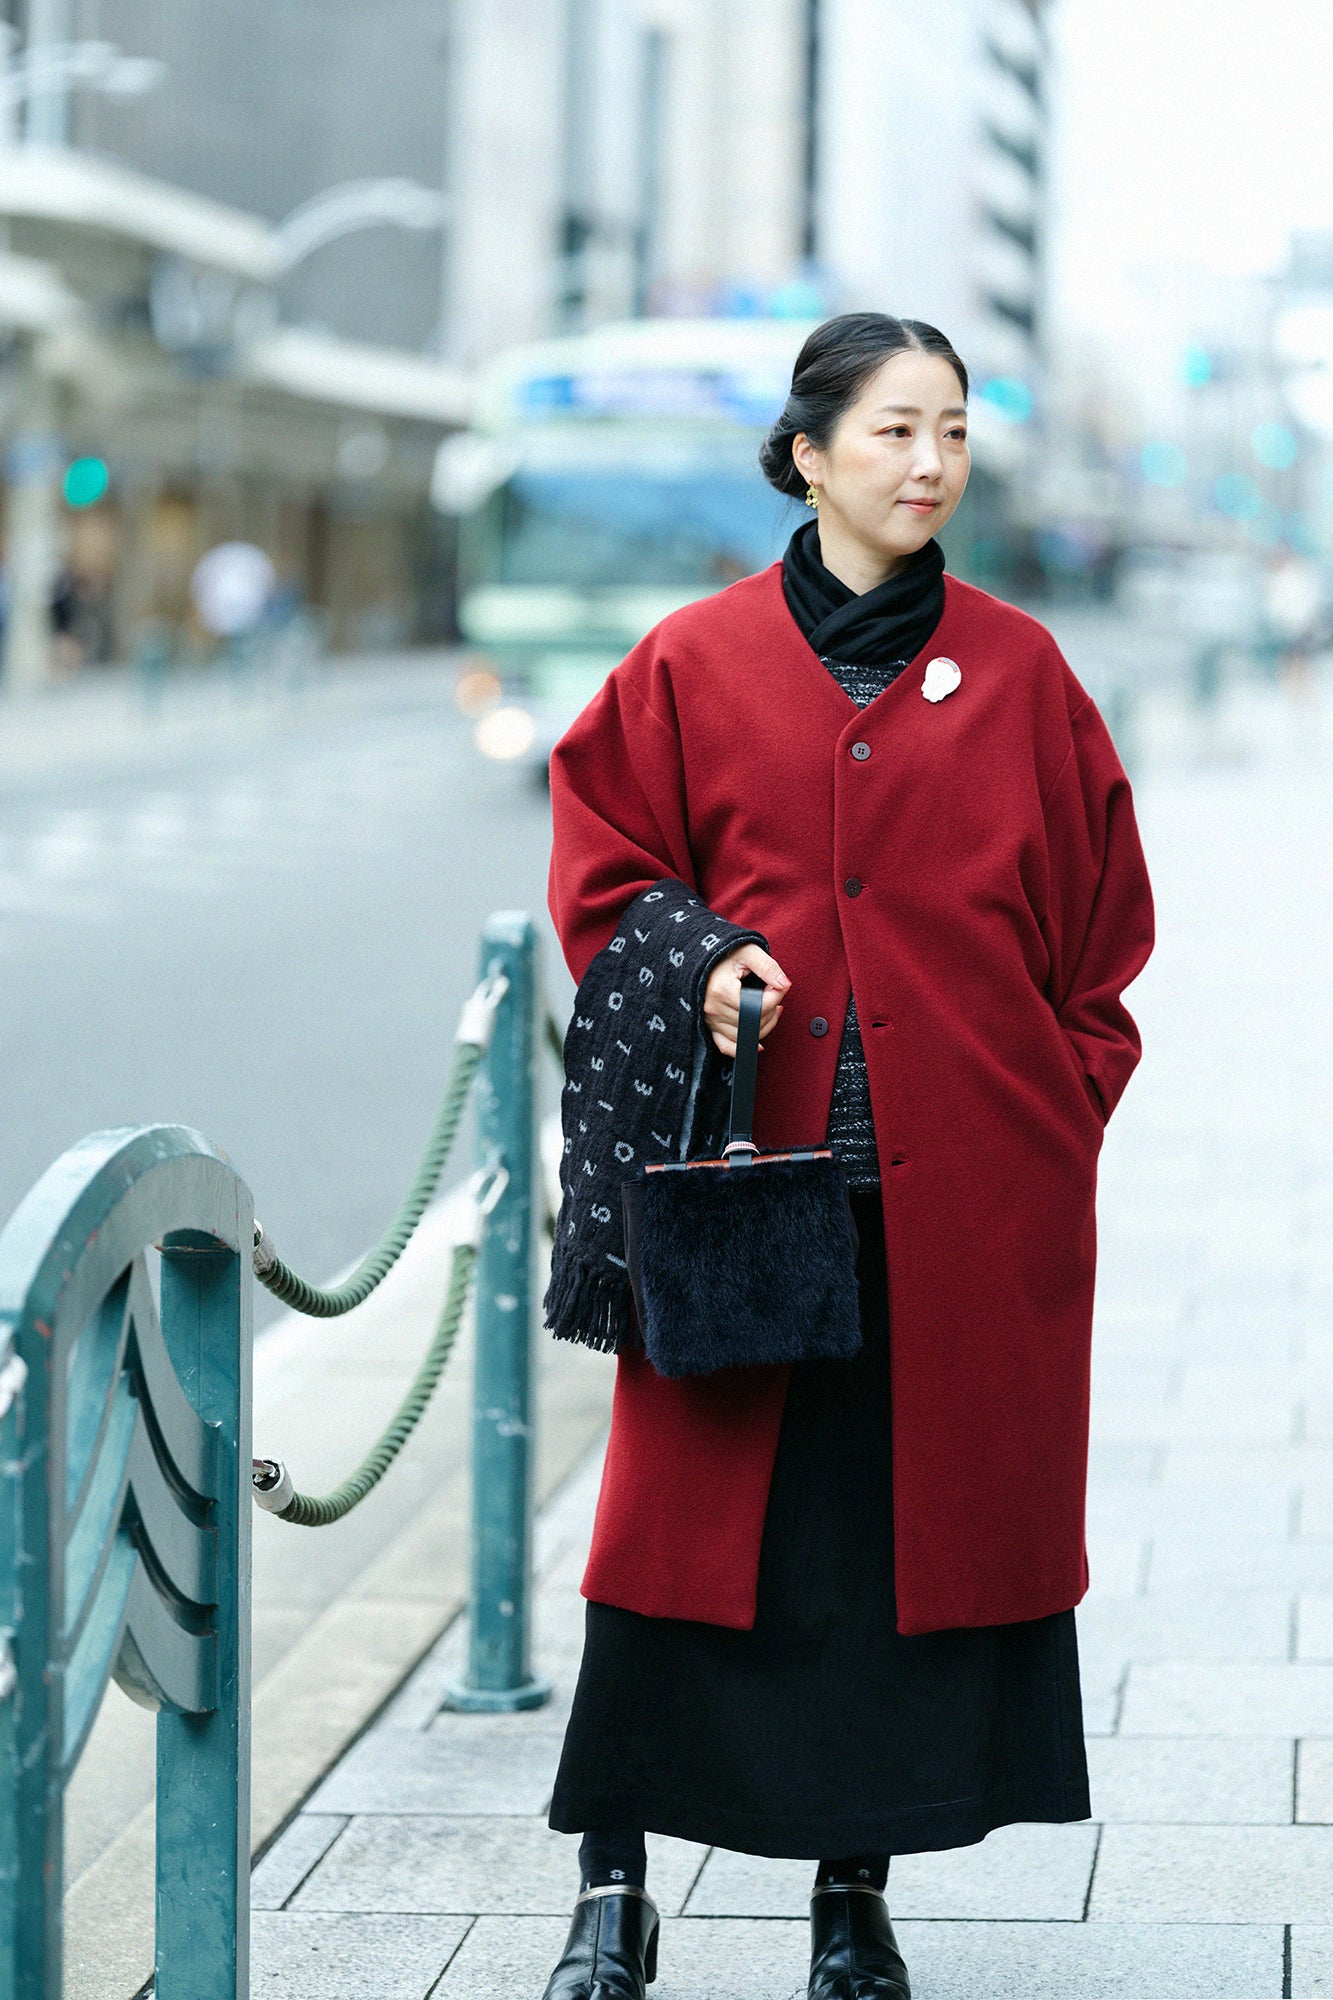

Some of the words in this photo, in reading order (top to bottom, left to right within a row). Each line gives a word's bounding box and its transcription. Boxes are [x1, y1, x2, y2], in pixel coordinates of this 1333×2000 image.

[643, 891, 664, 903] 0
[668, 910, 690, 923] 2
[608, 936, 627, 953] 8
[700, 933, 721, 951] 8
[608, 991, 623, 1011] 0
[646, 1013, 667, 1032] 4
[664, 1062, 686, 1085] 5
[633, 1079, 654, 1096] 3
[651, 1130, 673, 1149] 7
[614, 1140, 635, 1163] 0
[582, 1159, 597, 1177] 2
